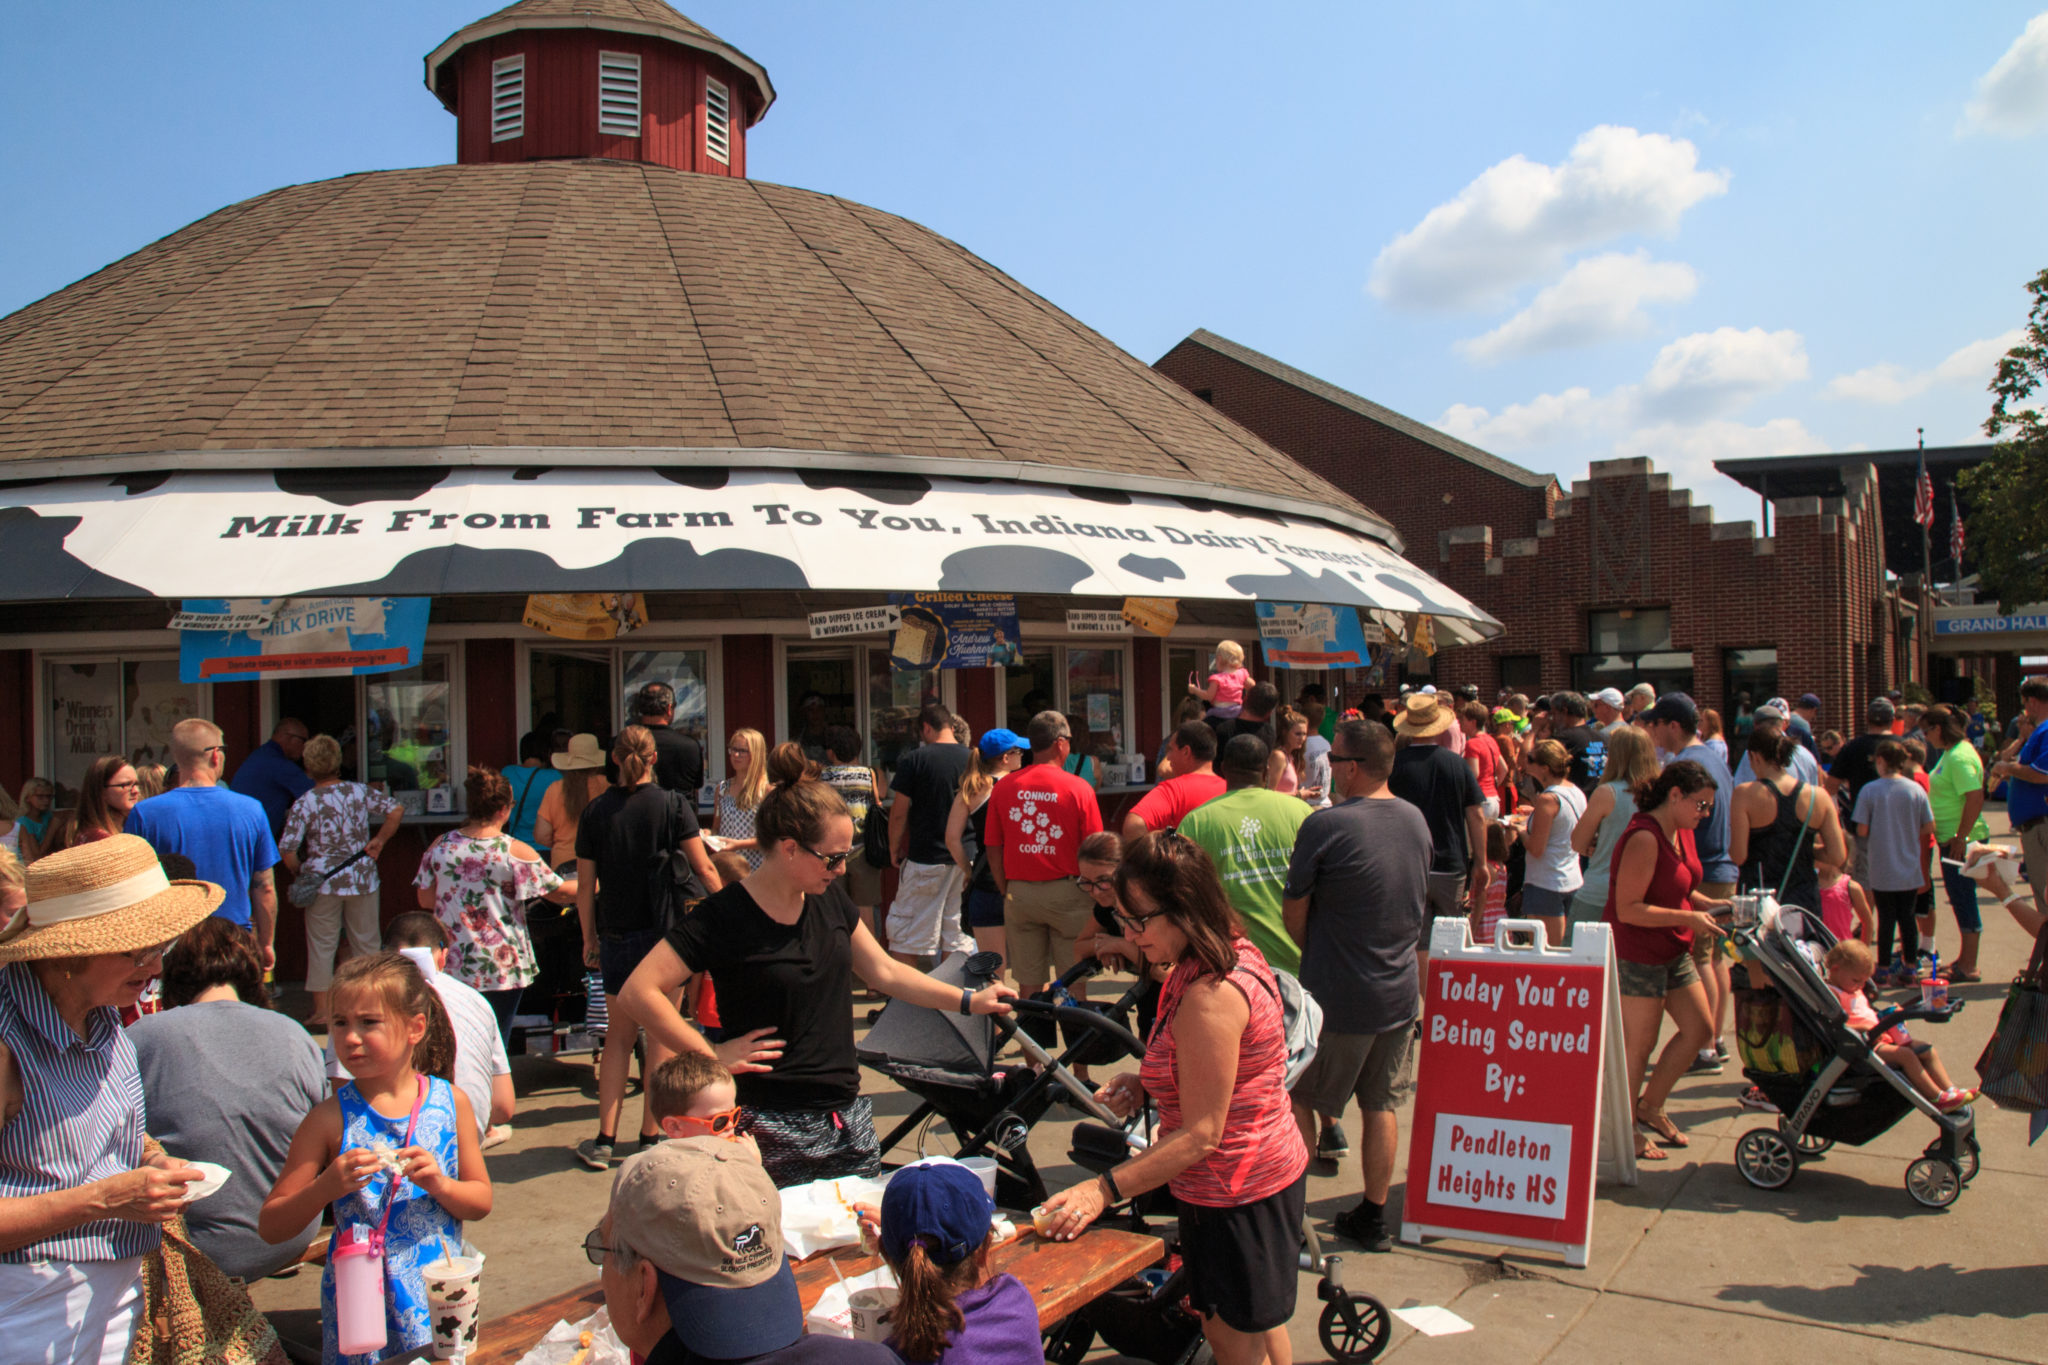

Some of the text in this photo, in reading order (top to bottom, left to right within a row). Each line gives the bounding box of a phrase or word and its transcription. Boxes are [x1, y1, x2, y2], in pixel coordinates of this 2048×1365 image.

[220, 504, 1372, 567] Milk From Farm To You, Indiana Dairy Farmers
[915, 592, 1014, 602] Grilled Cheese
[809, 609, 887, 625] HAND DIPPED ICE CREAM
[1081, 613, 1097, 621] DIPPED
[1098, 613, 1106, 621] ICE
[1948, 618, 2007, 632] GRAND
[823, 624, 854, 634] WINDOWS
[877, 621, 884, 629] 10
[951, 633, 991, 644] Andrew
[258, 660, 282, 668] today
[66, 700, 114, 719] Winners
[65, 718, 96, 736] Drink
[70, 736, 97, 753] Milk
[1017, 790, 1058, 803] CONNOR
[1019, 843, 1056, 855] COOPER
[1439, 971, 1590, 1012] Today You're
[1430, 1014, 1591, 1056] Being Served
[1485, 1062, 1526, 1103] By:
[1791, 1088, 1820, 1131] BRAVO
[1451, 1124, 1552, 1161] Pendleton
[1437, 1164, 1557, 1206] Heights HS
[720, 1264, 746, 1273] SLOUGH
